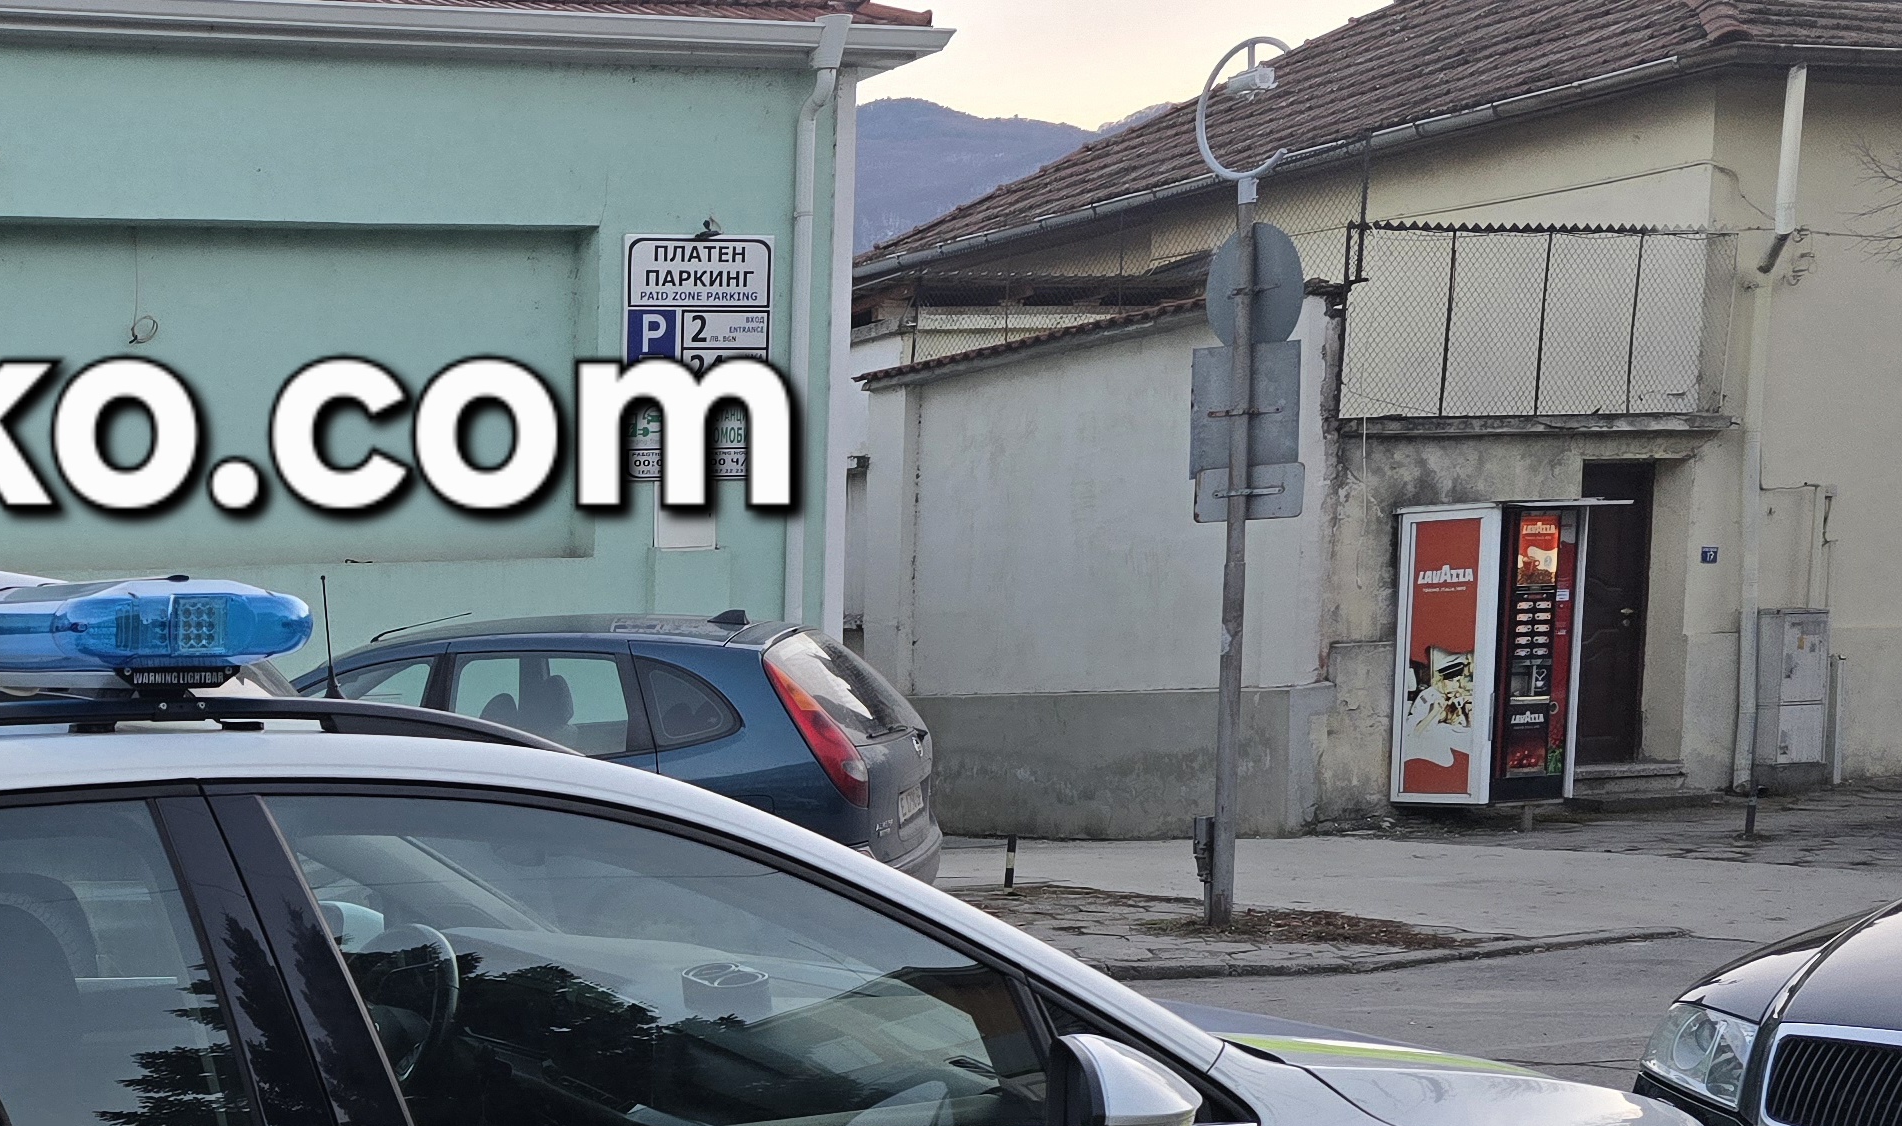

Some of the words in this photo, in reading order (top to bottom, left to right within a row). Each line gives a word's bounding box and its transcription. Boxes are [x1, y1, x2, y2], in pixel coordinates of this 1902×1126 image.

[654, 245, 746, 263] ПЛАТЕН
[645, 269, 755, 288] ПАРКИНГ
[640, 291, 669, 301] PAID
[672, 291, 702, 301] ZONE
[706, 291, 758, 302] PARKING
[745, 316, 765, 325] ВХОД
[641, 313, 667, 353] P
[691, 314, 707, 343] 2
[728, 326, 764, 334] ENTRANCE
[722, 335, 737, 343] BGN
[1521, 521, 1556, 535] LAVAZZA
[1417, 564, 1474, 585] LAVAZZA
[133, 672, 178, 684] WARNING
[179, 671, 224, 684] LIGHTBAR
[1510, 710, 1545, 724] LAVAZZA
